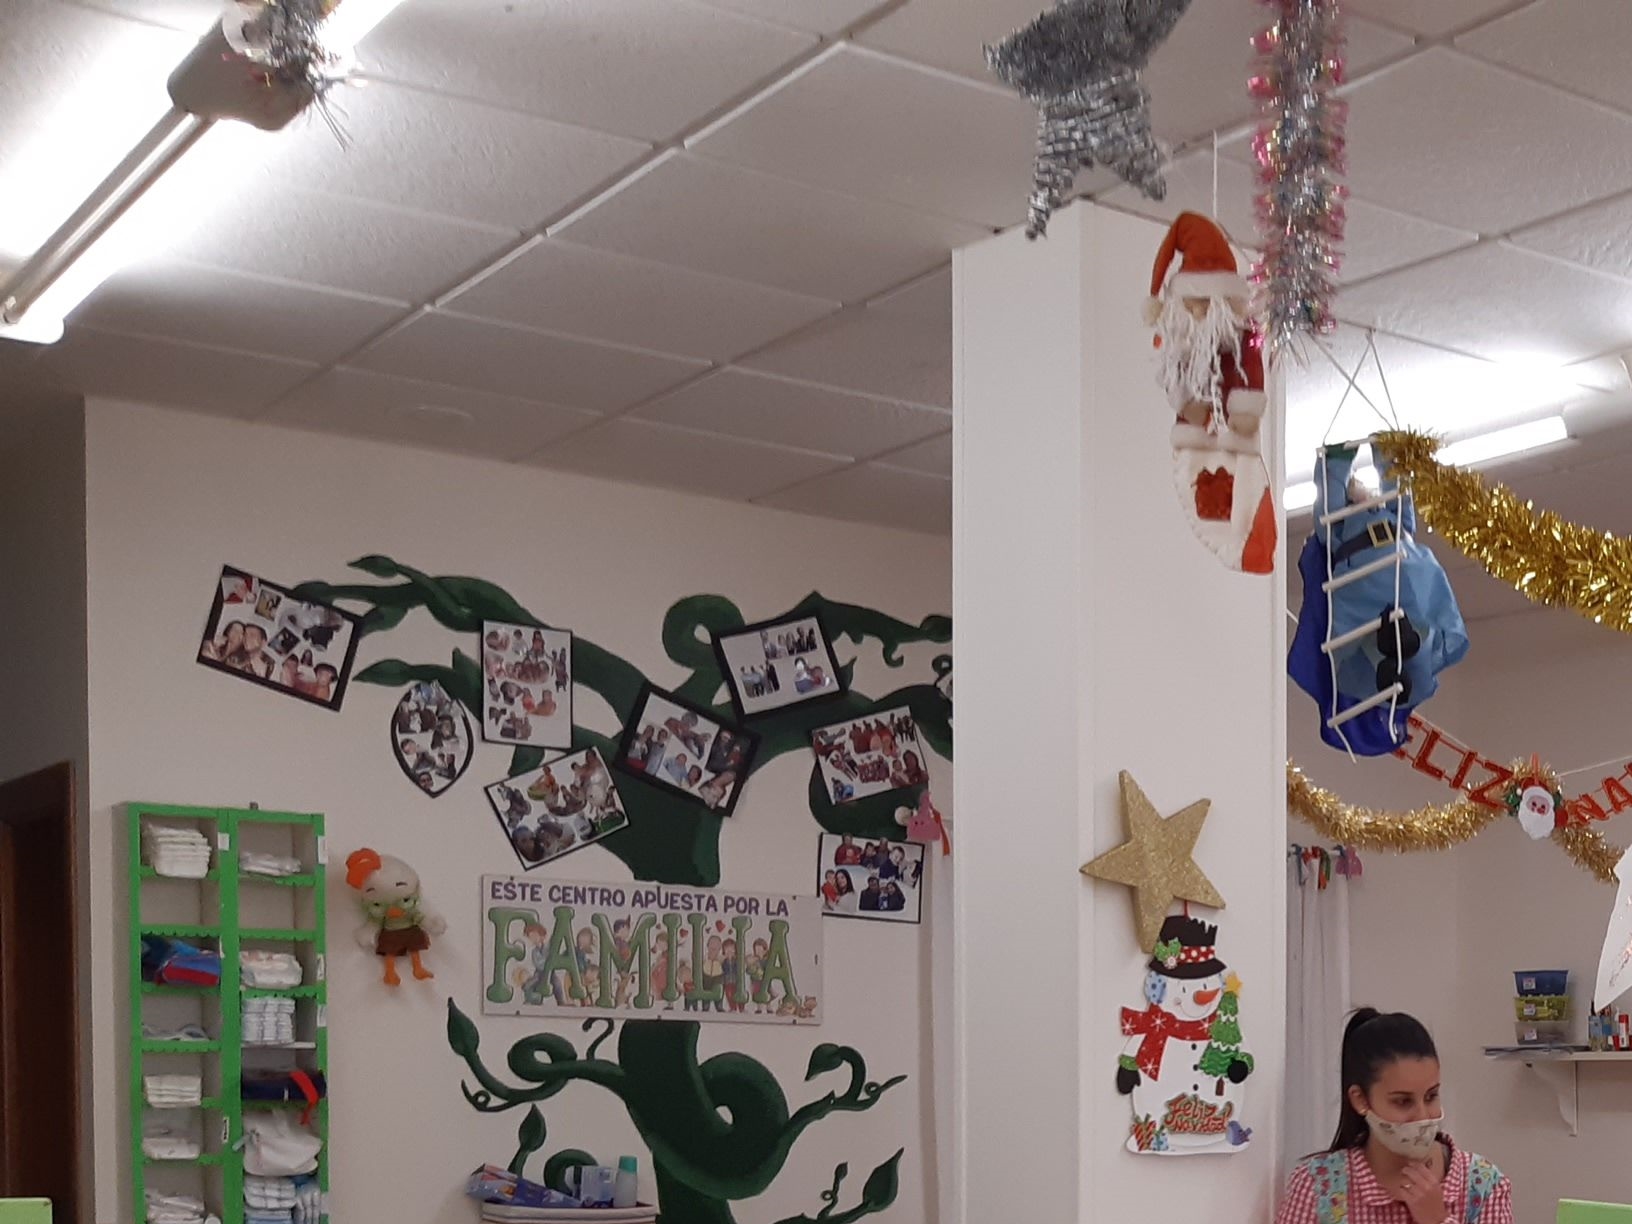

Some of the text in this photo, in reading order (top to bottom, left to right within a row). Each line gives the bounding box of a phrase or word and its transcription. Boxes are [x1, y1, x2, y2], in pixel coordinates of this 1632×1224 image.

[491, 881, 789, 917] ESTE CENTRO APUESTA POR LA
[487, 906, 799, 1009] FAMILIA
[1164, 1092, 1217, 1126] Feliz
